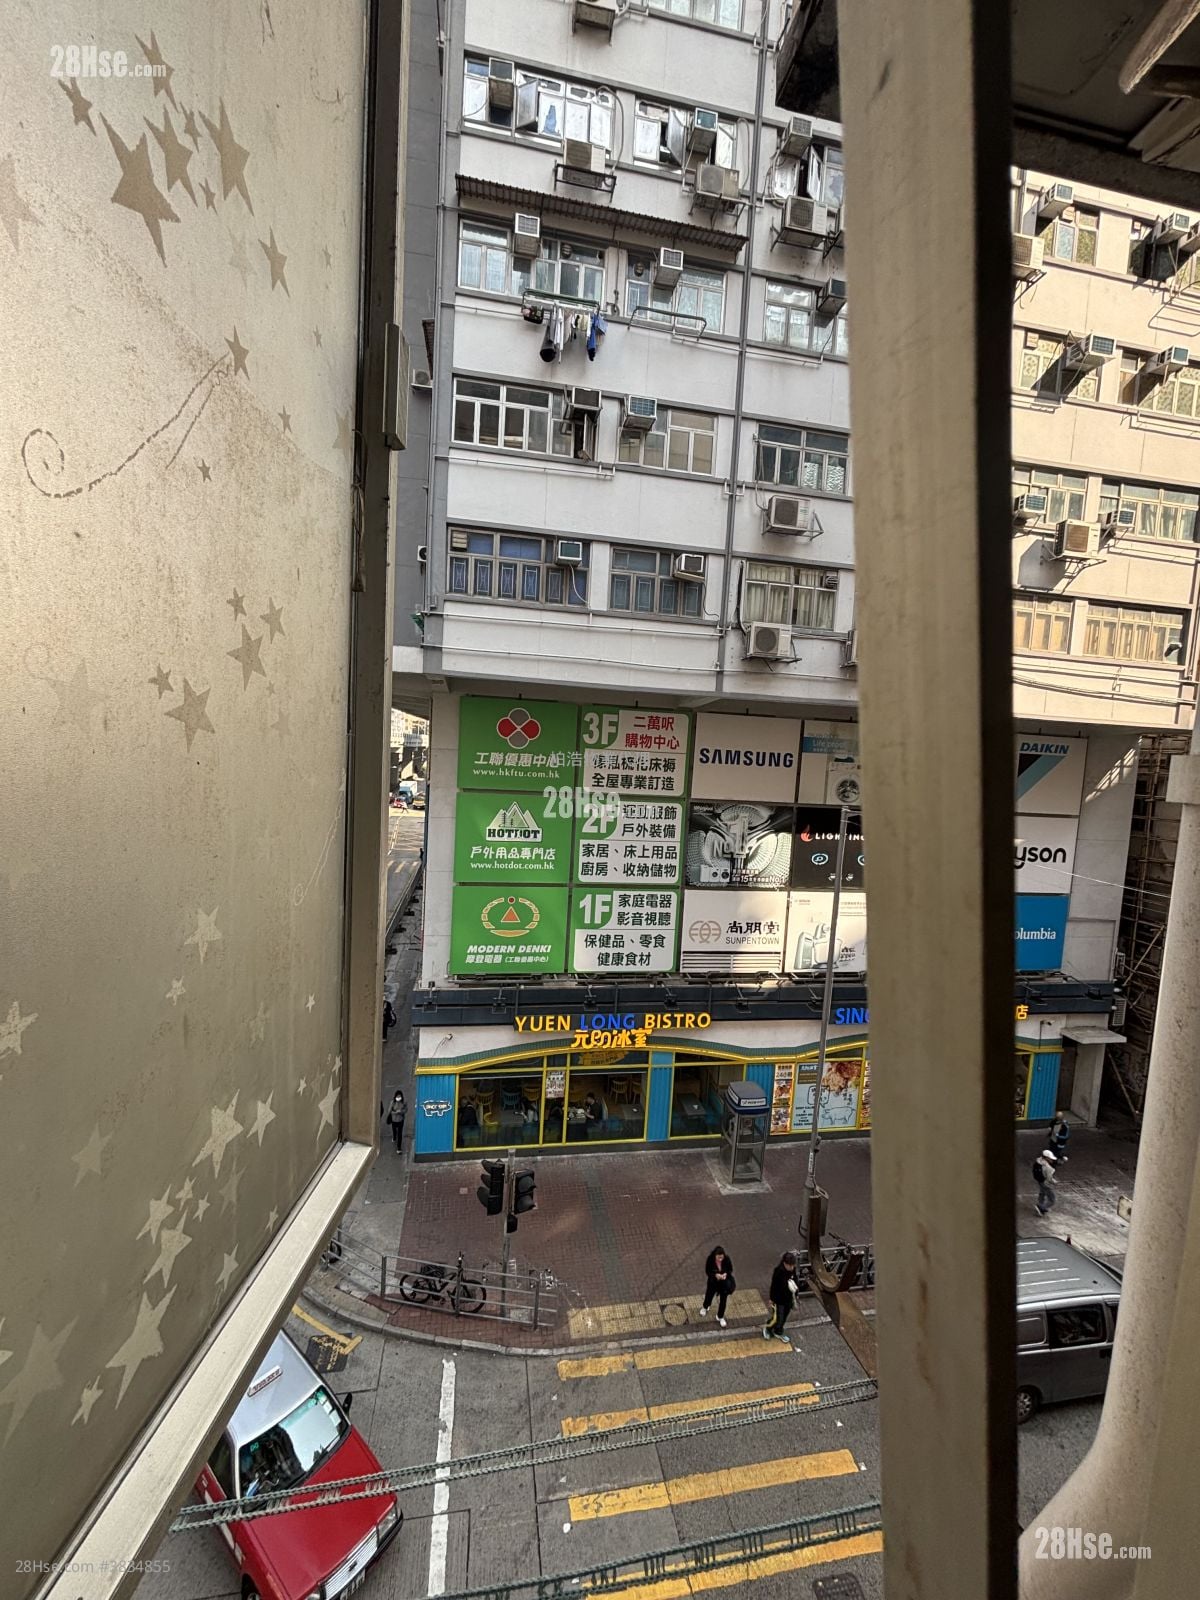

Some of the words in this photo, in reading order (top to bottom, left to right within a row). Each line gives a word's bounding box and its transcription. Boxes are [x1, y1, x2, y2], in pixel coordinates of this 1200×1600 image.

[583, 712, 619, 745] 3F
[634, 715, 675, 731] 二萬呎
[625, 733, 680, 749] 購物中心
[1020, 742, 1069, 754] DAIKIN
[474, 752, 558, 768] 工聯優惠中心
[699, 748, 794, 768] SAMSUNG
[473, 768, 560, 779] www.hkftu.com.hk
[592, 773, 675, 791] 全屋專業訂造
[582, 802, 617, 834] 2F
[623, 804, 677, 820] 運動服飾
[488, 828, 540, 839] HOTDOT
[622, 823, 676, 839] 戶外裝備
[815, 832, 864, 841] LIGHIN
[470, 846, 556, 860] 戶外用品專門店
[582, 843, 677, 860] 家居、床上用品
[470, 861, 554, 870] www.hotdot.com.hk
[581, 861, 677, 878] 廚房、收納儲物
[579, 893, 612, 924] 1F
[618, 893, 672, 908] 家庭電器
[617, 911, 672, 926] 影音視聽
[726, 921, 780, 935] 尚朋堂
[584, 933, 666, 949] 保健品、零食
[725, 936, 780, 945] SUNPENTOWN
[467, 945, 516, 954] MODERN
[518, 944, 552, 953] DENKI
[597, 952, 651, 967] 健康食材
[515, 1015, 571, 1033] YUEN
[580, 1014, 636, 1031] LONG
[645, 1012, 711, 1030] BISTRO
